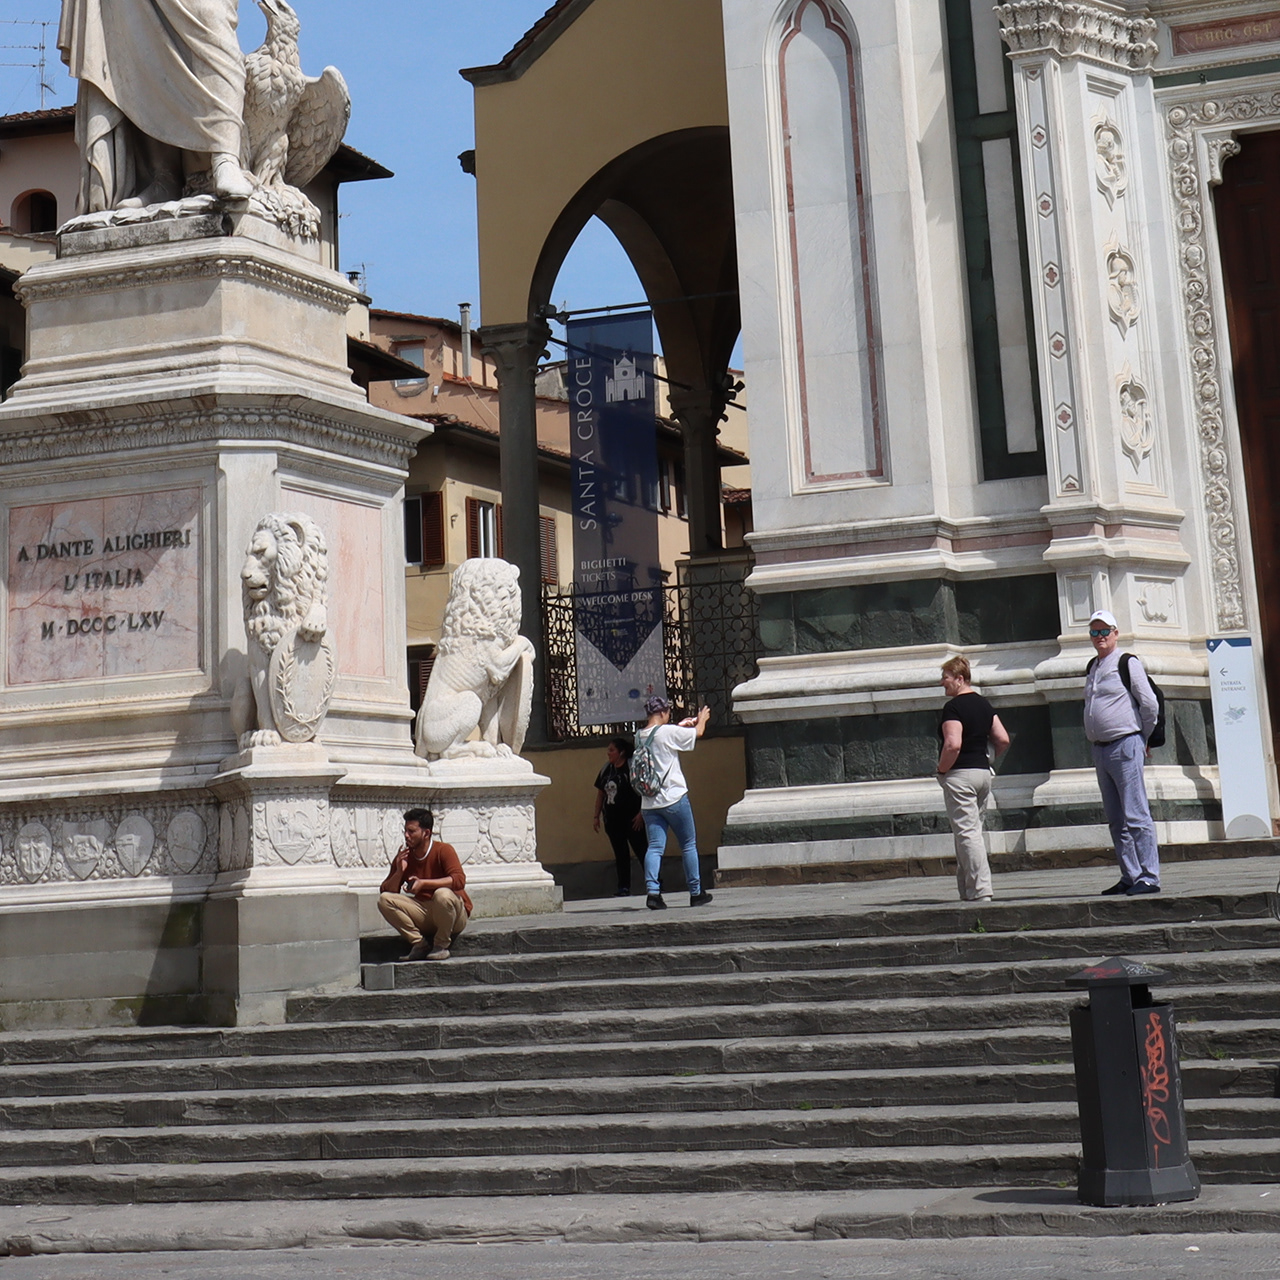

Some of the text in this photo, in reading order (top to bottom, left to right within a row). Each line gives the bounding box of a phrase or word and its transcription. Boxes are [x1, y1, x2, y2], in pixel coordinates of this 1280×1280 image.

[574, 356, 598, 531] SANTA CROCE
[36, 539, 94, 561] DANTE
[102, 529, 192, 553] ALIGHIERI
[581, 557, 627, 570] BIGLIETTI
[83, 567, 145, 590] ITALIA
[581, 571, 616, 583] TICKETS
[582, 591, 654, 606] WELCOME DESK
